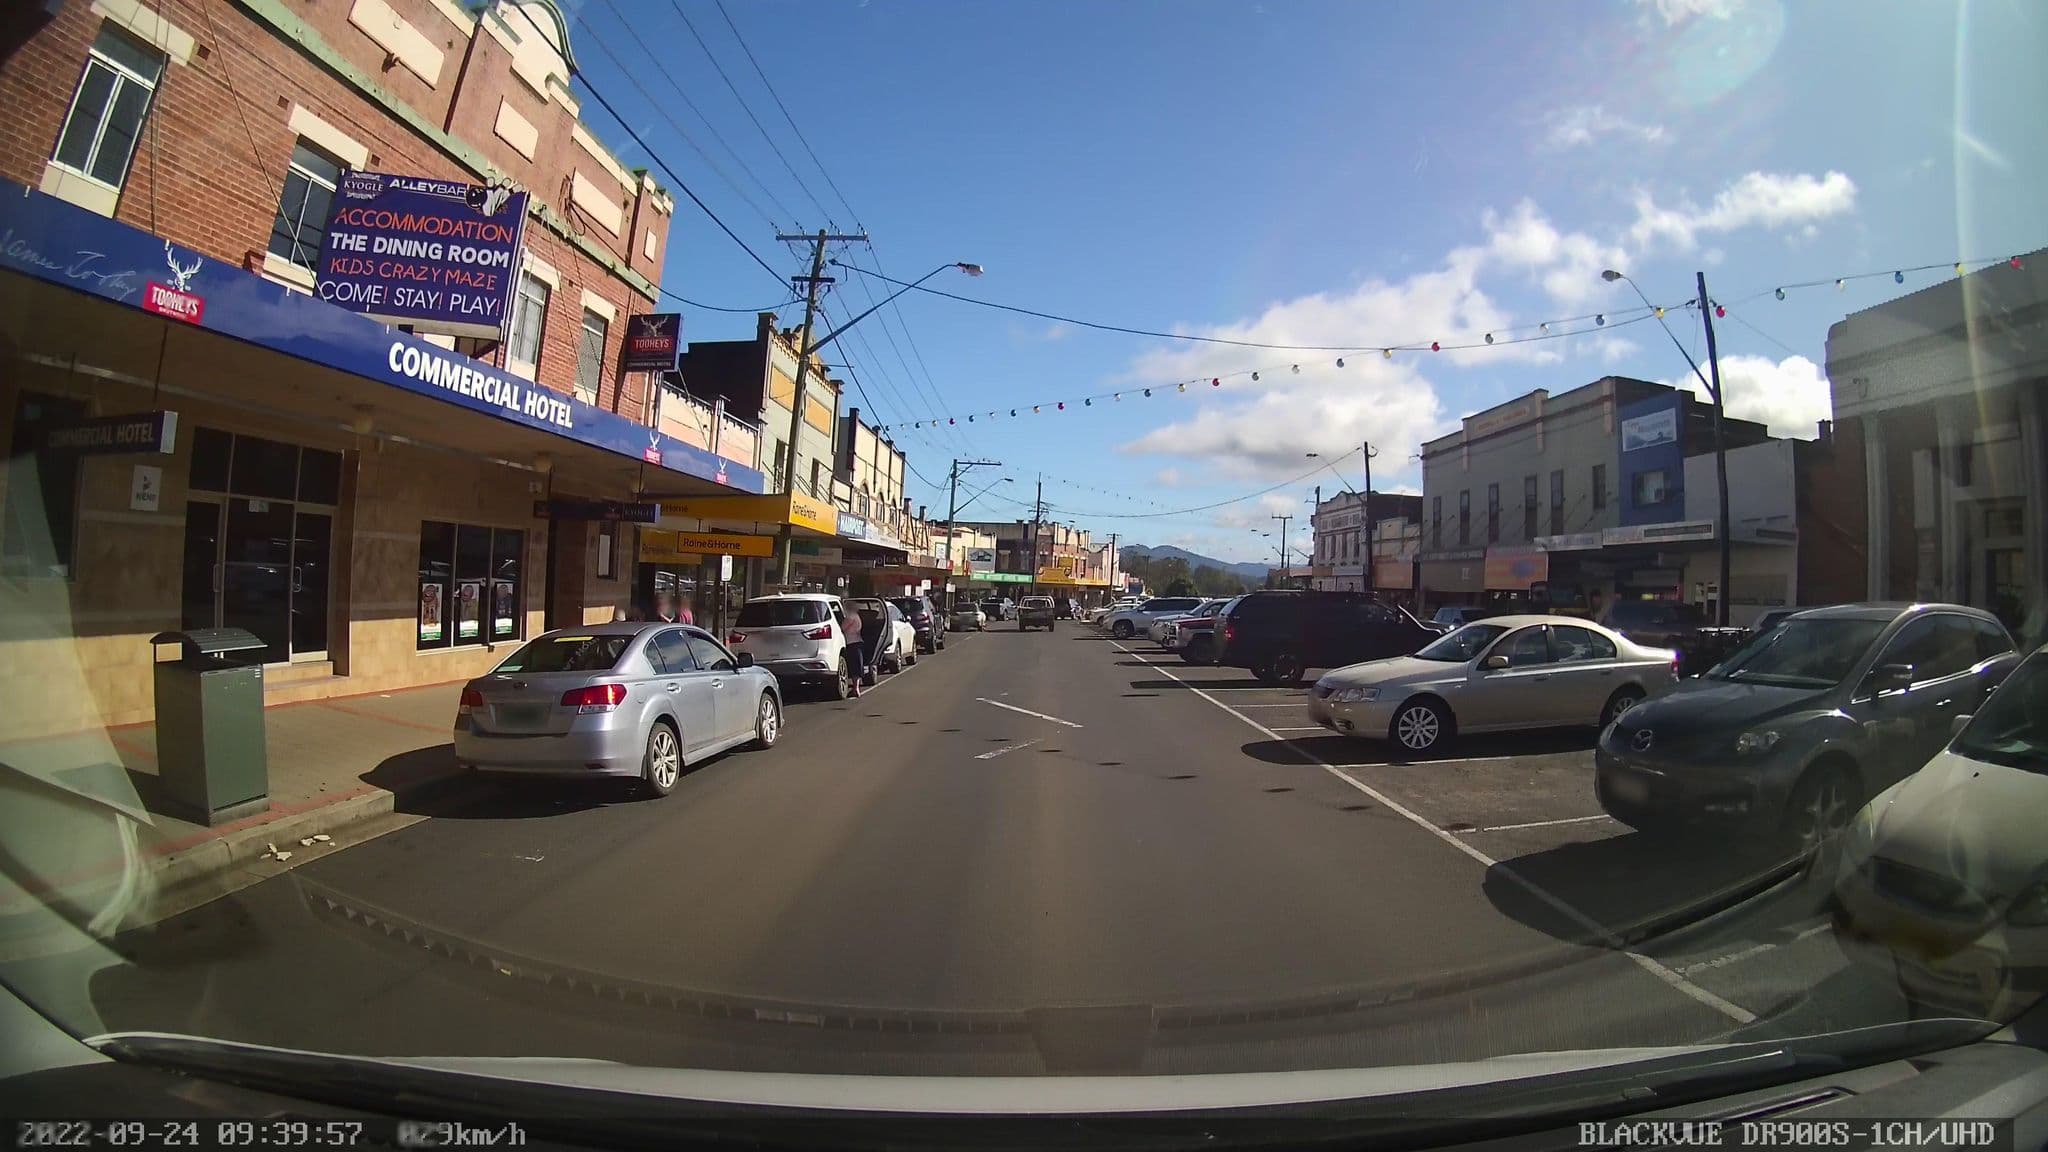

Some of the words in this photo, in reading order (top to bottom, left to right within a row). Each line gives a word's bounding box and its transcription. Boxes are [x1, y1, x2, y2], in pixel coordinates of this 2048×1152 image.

[343, 181, 384, 192] KYOGLE
[334, 207, 514, 244] ACCOMMODATION
[330, 232, 368, 252] THE
[373, 236, 443, 261] DINING
[447, 245, 511, 268] ROOM
[330, 257, 375, 276] KIDS
[379, 262, 442, 283] CRAZY
[445, 268, 498, 291] MAZE
[320, 280, 388, 305] COME!
[393, 287, 444, 310] STAY!
[450, 293, 500, 316] PLAY!
[634, 338, 670, 349] TOOHEYS
[389, 342, 520, 411] COMMERCIAL
[524, 390, 573, 428] HOTEL
[117, 422, 155, 444] HOTEL
